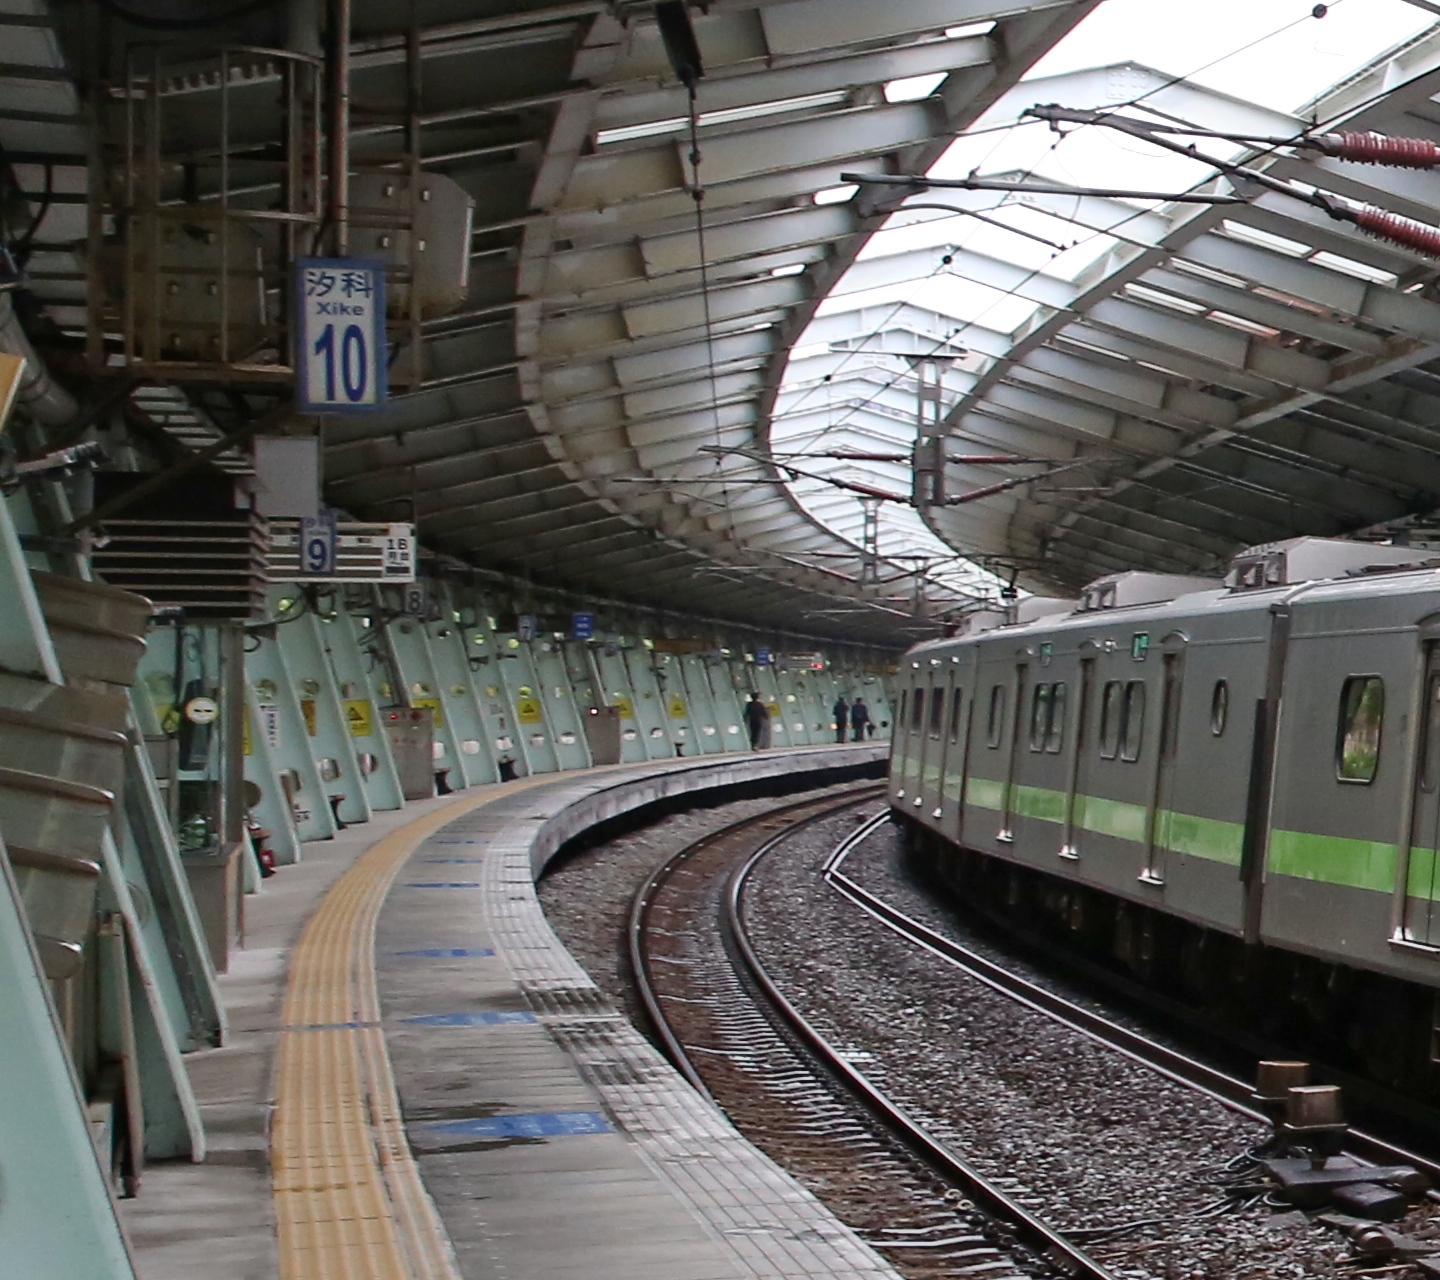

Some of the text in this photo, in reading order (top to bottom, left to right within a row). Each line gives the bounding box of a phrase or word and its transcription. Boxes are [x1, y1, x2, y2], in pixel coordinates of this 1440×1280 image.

[307, 271, 374, 299] 汐科
[316, 301, 365, 316] Xike
[314, 323, 367, 403] 10
[307, 538, 328, 571] 9
